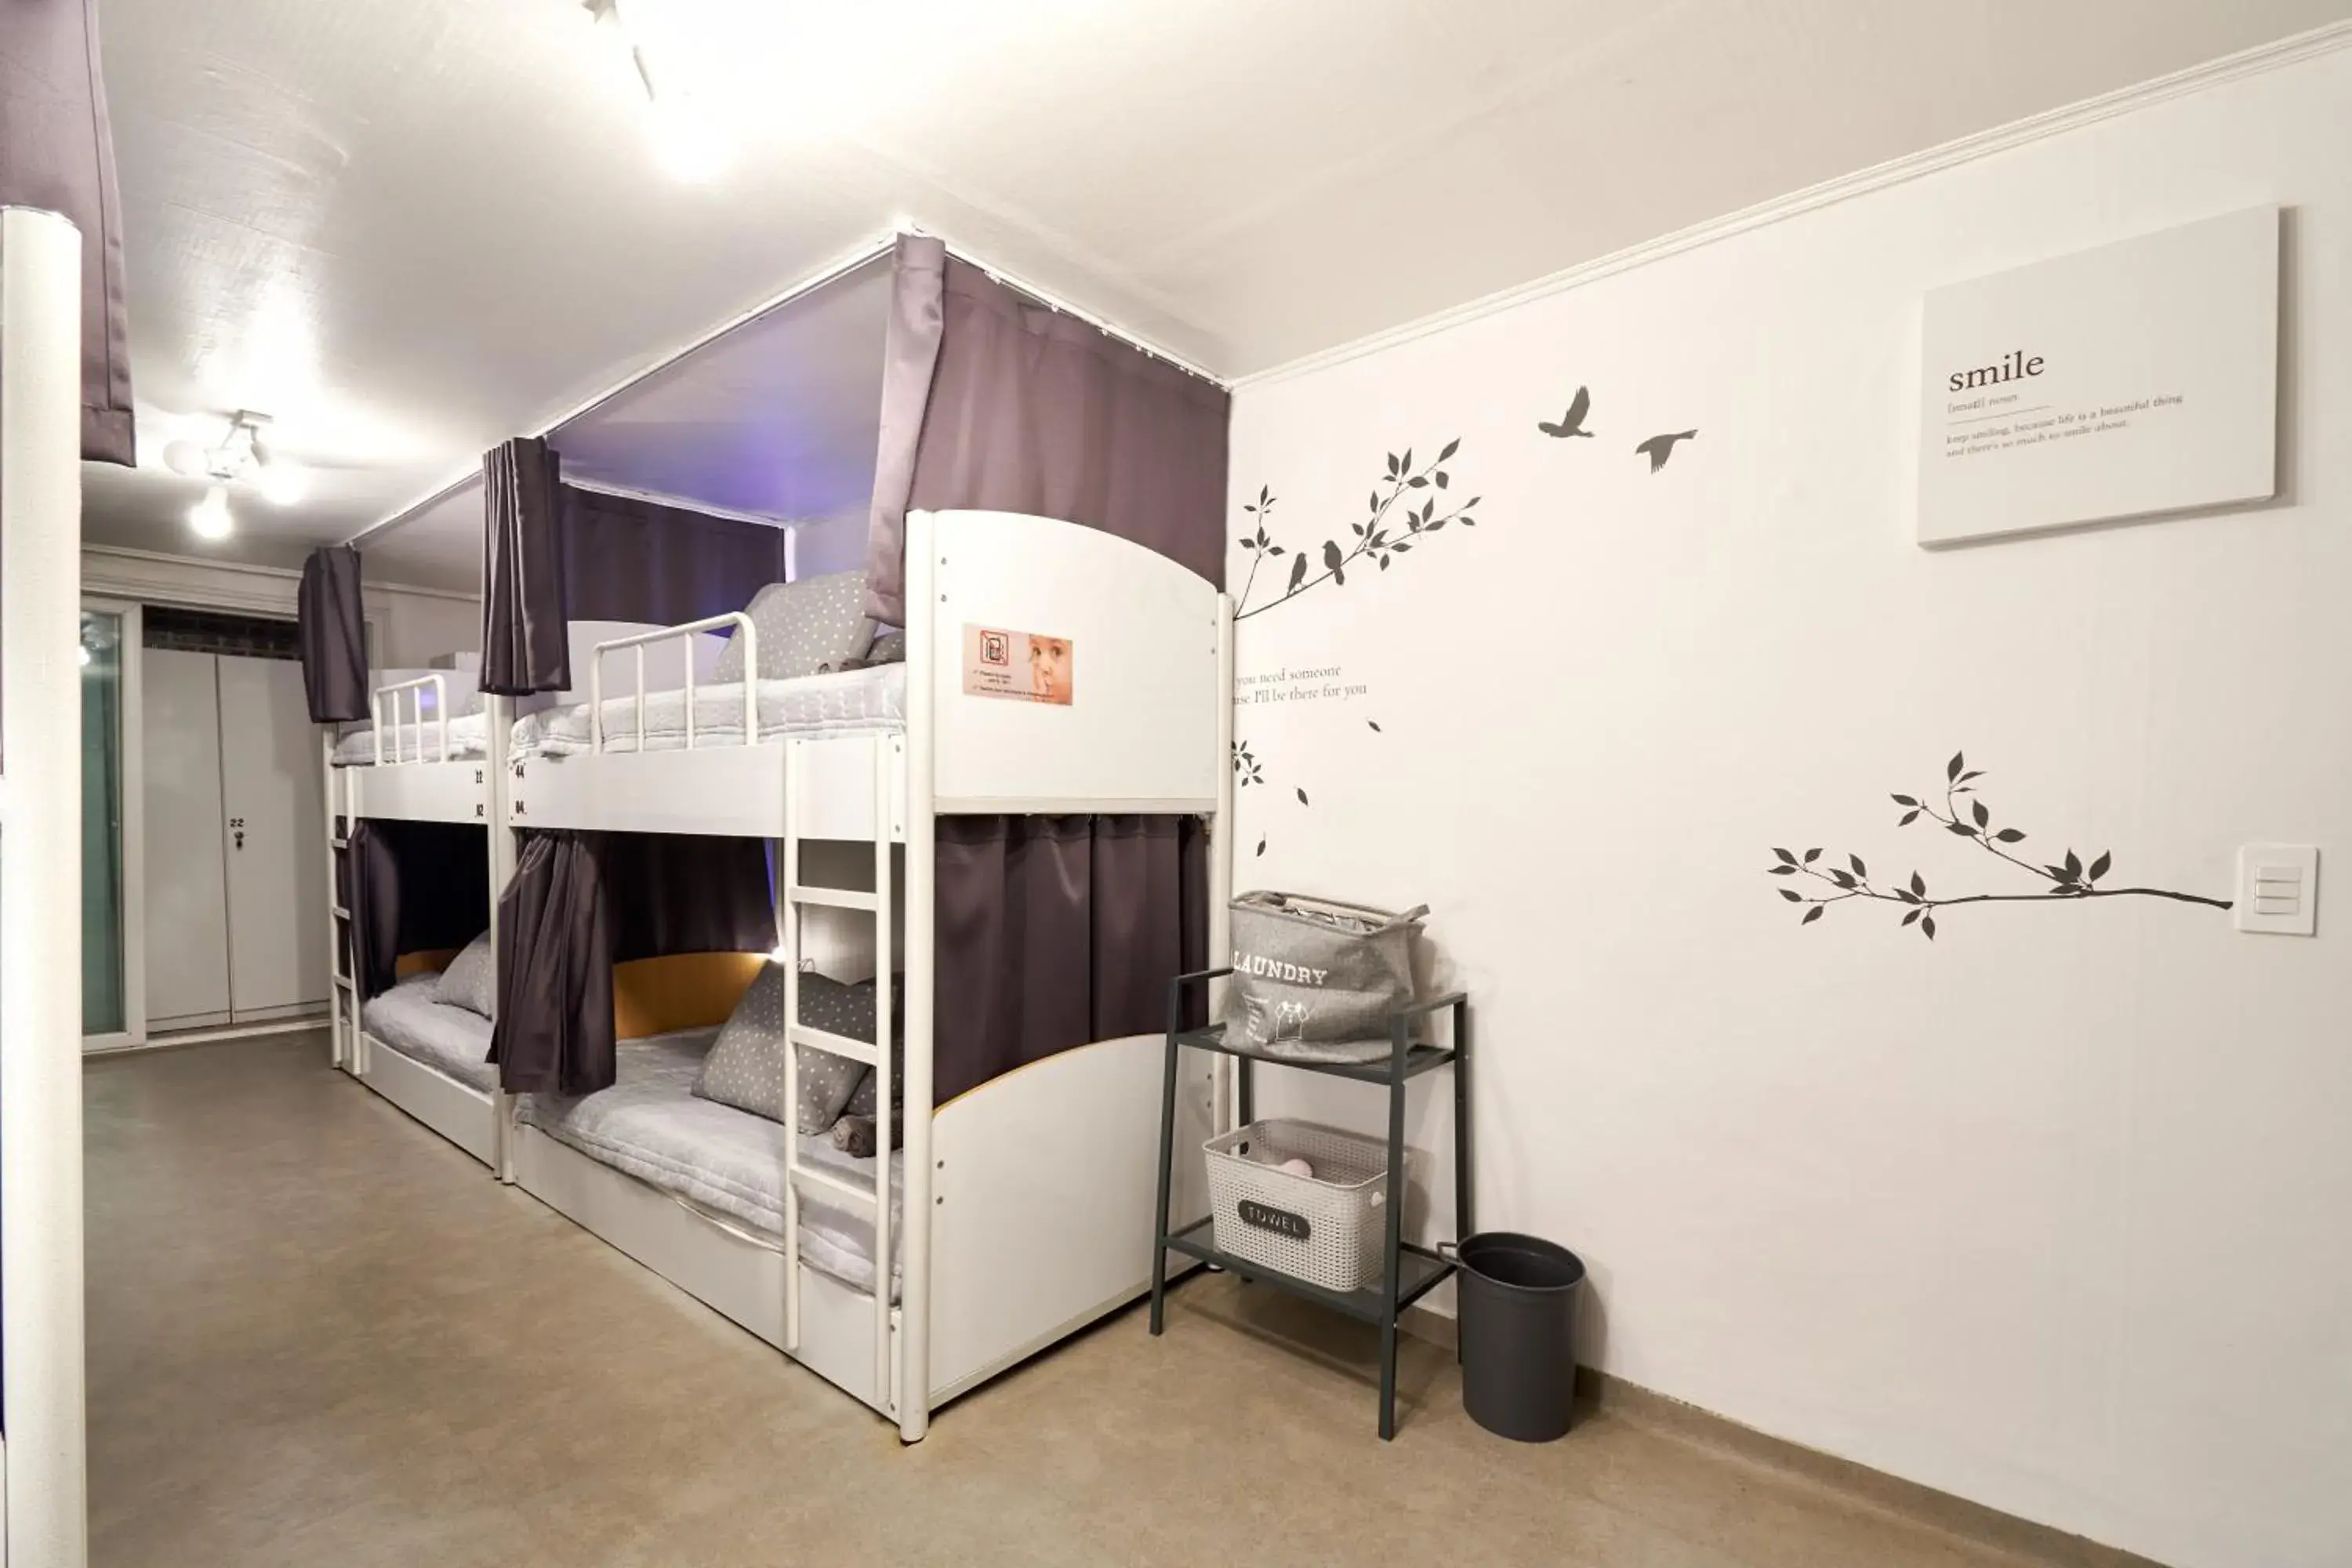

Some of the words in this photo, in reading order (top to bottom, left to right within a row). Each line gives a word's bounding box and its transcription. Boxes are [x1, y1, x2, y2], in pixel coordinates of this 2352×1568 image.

[1948, 350, 2045, 392] smile
[2015, 417, 2056, 433] because
[2058, 412, 2075, 425] life
[2078, 411, 2087, 421] is
[2100, 400, 2150, 417] beautiful
[2153, 394, 2184, 408] thing
[1946, 445, 1965, 458] and
[1967, 439, 1999, 456] there's
[2016, 433, 2046, 448] much
[2063, 423, 2092, 438] smile
[1236, 676, 1256, 691] you
[1260, 667, 1286, 684] need
[1290, 666, 1341, 681] someone
[1254, 689, 1269, 703] I'll
[1272, 688, 1287, 702] be
[1290, 685, 1319, 701] there
[1323, 683, 1341, 698] for
[1345, 684, 1368, 702] you
[230, 818, 245, 827] 22
[1233, 951, 1328, 985] LAUNDRY
[1247, 1206, 1301, 1233] TOWEL
